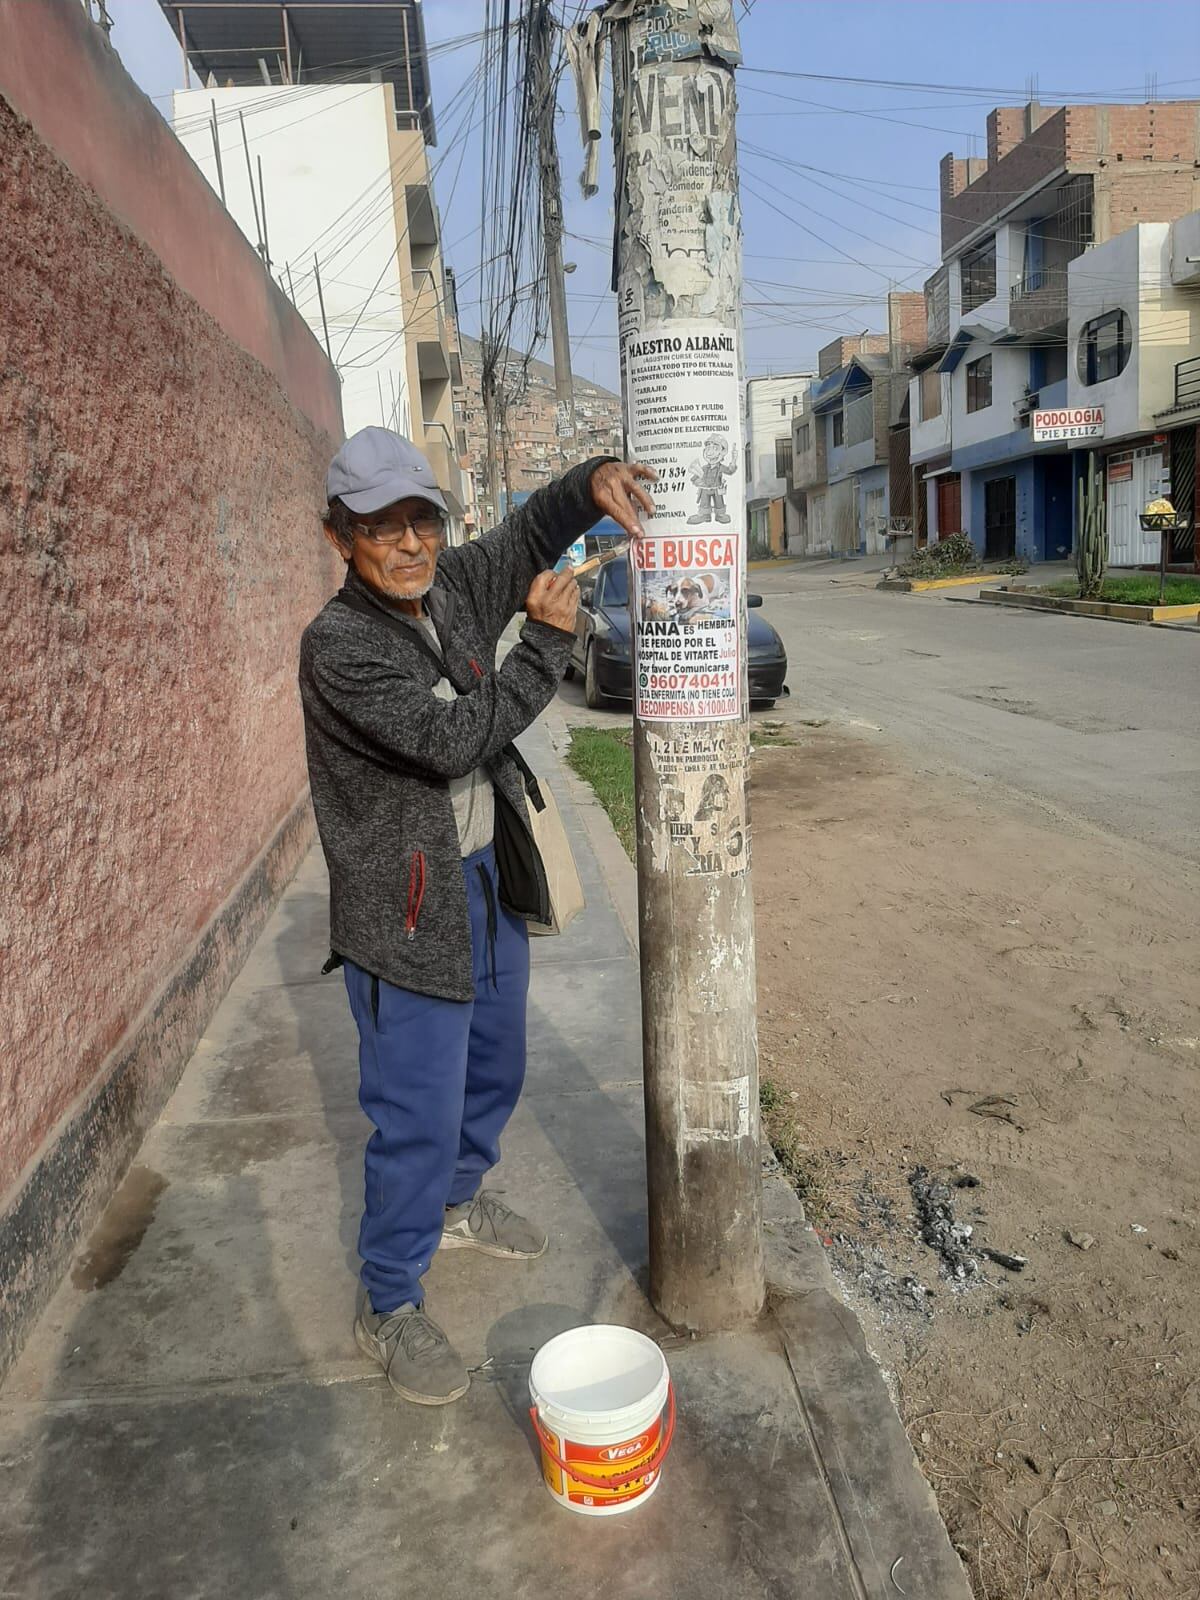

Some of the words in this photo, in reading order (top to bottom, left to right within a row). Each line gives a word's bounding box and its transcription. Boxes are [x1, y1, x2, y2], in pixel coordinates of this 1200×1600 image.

[685, 333, 734, 352] ALBAÑIL
[662, 362, 680, 370] TODO
[682, 361, 697, 369] TIPO
[649, 405, 694, 415] FROTACHADO
[1036, 409, 1102, 426] PODOLOGIA
[685, 425, 730, 433] ELECTRICIDAD
[669, 467, 686, 478] 834
[653, 482, 669, 493] 233
[671, 482, 685, 492] 411
[637, 541, 656, 568] SE
[663, 539, 734, 568] BUSCA
[637, 622, 680, 636] NANA
[683, 625, 695, 635] ES
[697, 619, 736, 630] HEMBRITA
[651, 638, 681, 648] PERDIO
[684, 638, 703, 648] POR
[705, 637, 716, 647] EL
[671, 651, 681, 660] DE
[684, 650, 718, 660] VITARTE
[640, 663, 650, 673] Por
[651, 664, 671, 674] favor
[673, 663, 730, 674] Comunicarse
[650, 672, 735, 689] 960740411
[651, 690, 685, 700] ENFERMITA
[702, 689, 720, 699] TIENE
[640, 701, 695, 716] RECOMPENSA
[608, 1441, 642, 1460] VEGA
